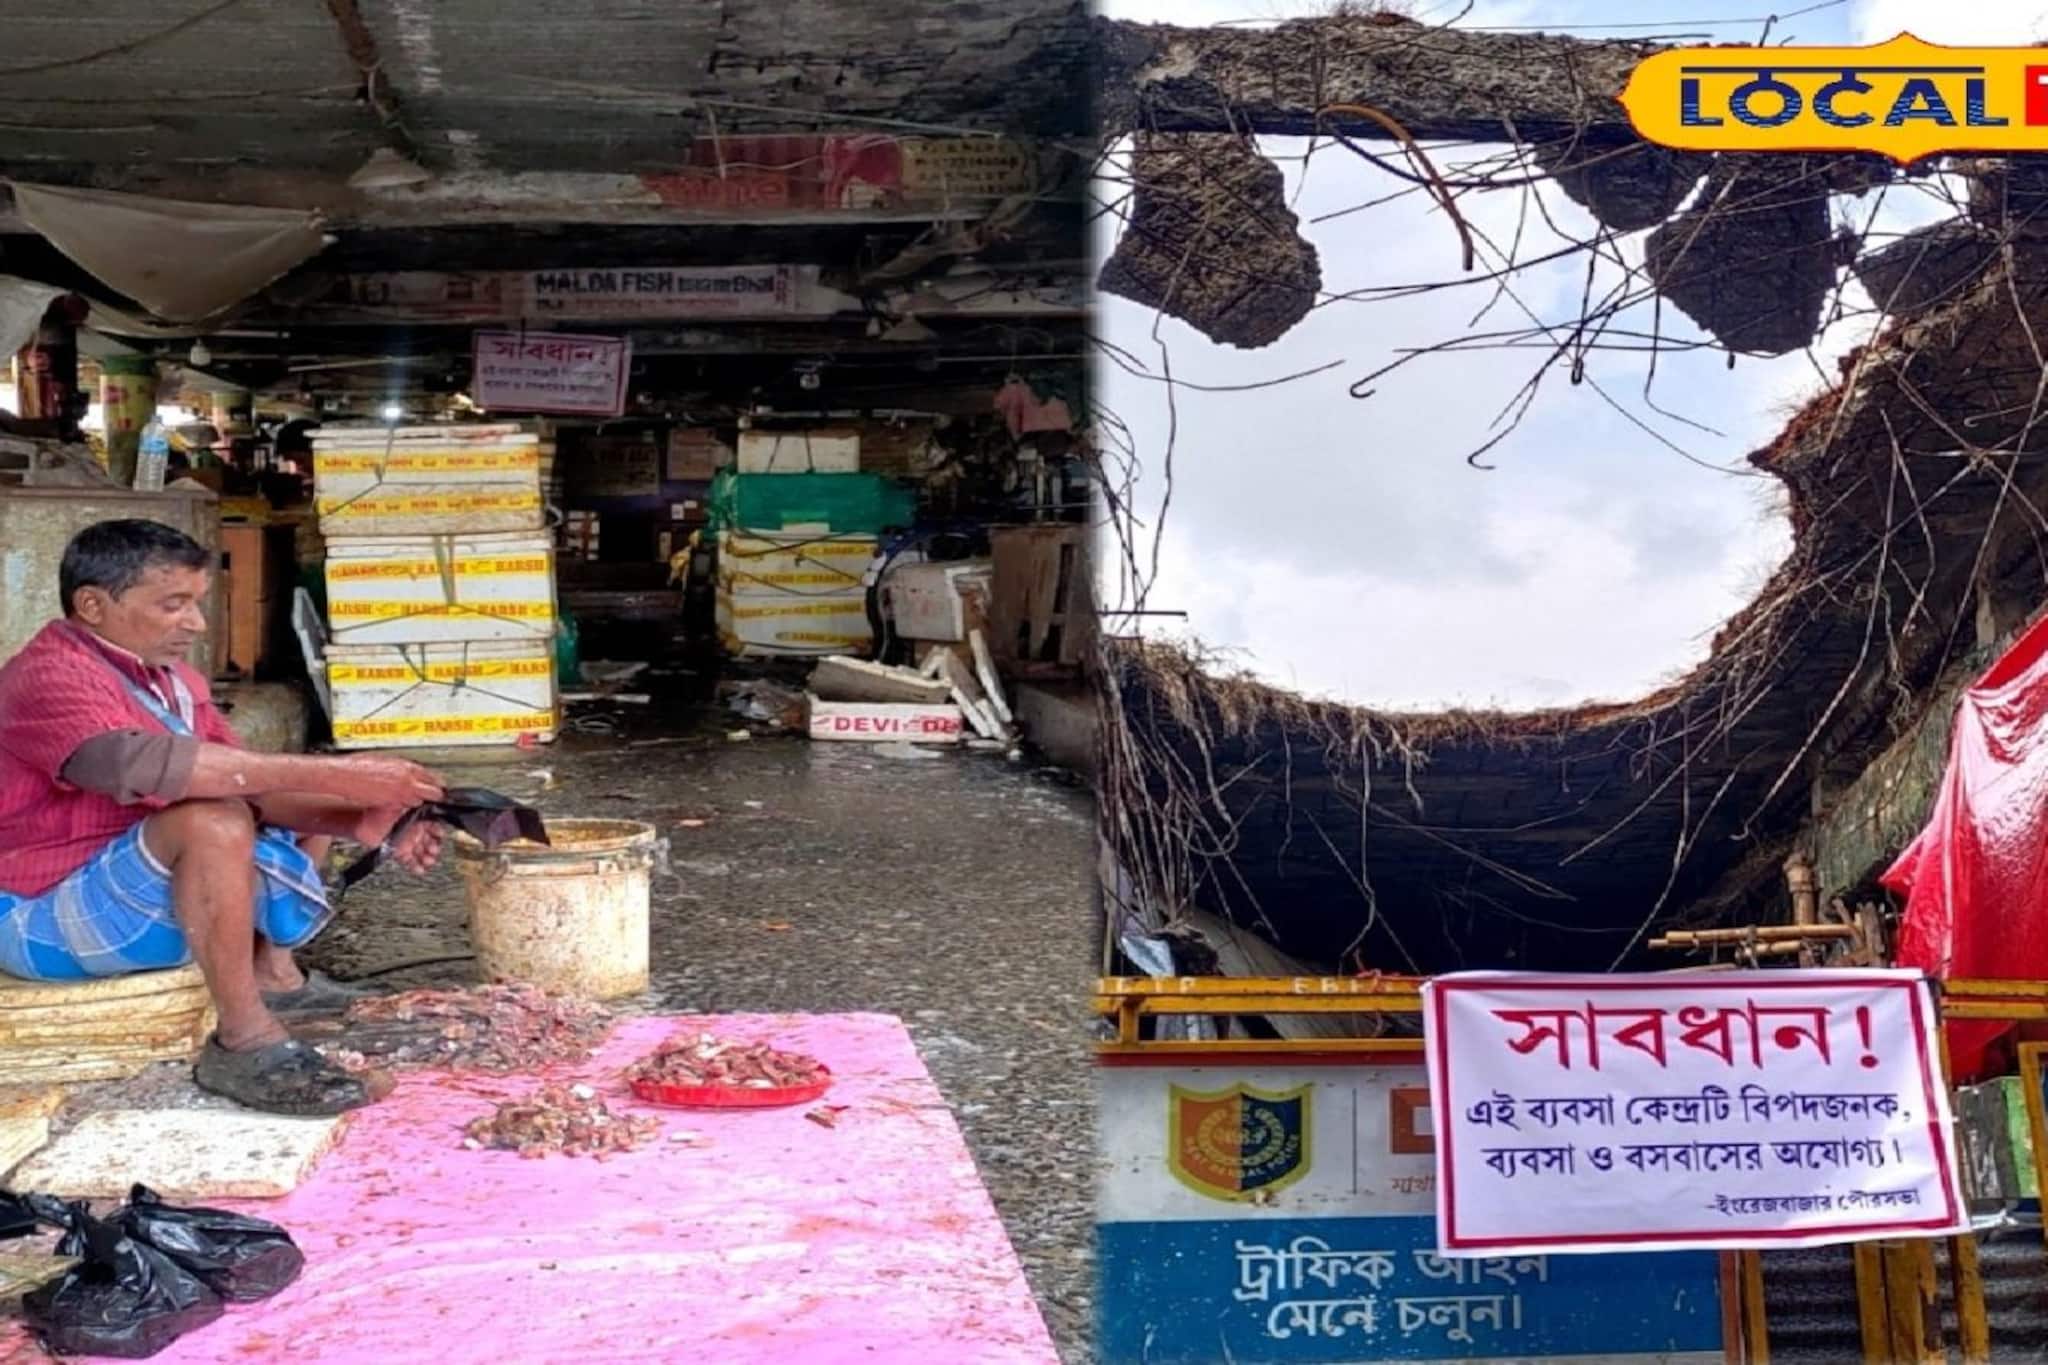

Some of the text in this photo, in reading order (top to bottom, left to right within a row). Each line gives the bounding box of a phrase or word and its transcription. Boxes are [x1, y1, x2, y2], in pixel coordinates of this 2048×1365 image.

[621, 270, 673, 293] FISH
[834, 716, 898, 732] DEVI
[1466, 1089, 1520, 1131] এই
[1523, 1093, 1614, 1128] ব্যবসা
[1626, 1085, 1731, 1125] কেন্দ্রটি
[1481, 1142, 1576, 1178] ব্যবসা
[1587, 1146, 1614, 1171] ও
[1620, 1139, 1763, 1173] বসবাসের
[1837, 1188, 1921, 1210] পৌরসভা
[1232, 1236, 1397, 1301] ট্রাফিক
[1267, 1295, 1378, 1339] মেনে
